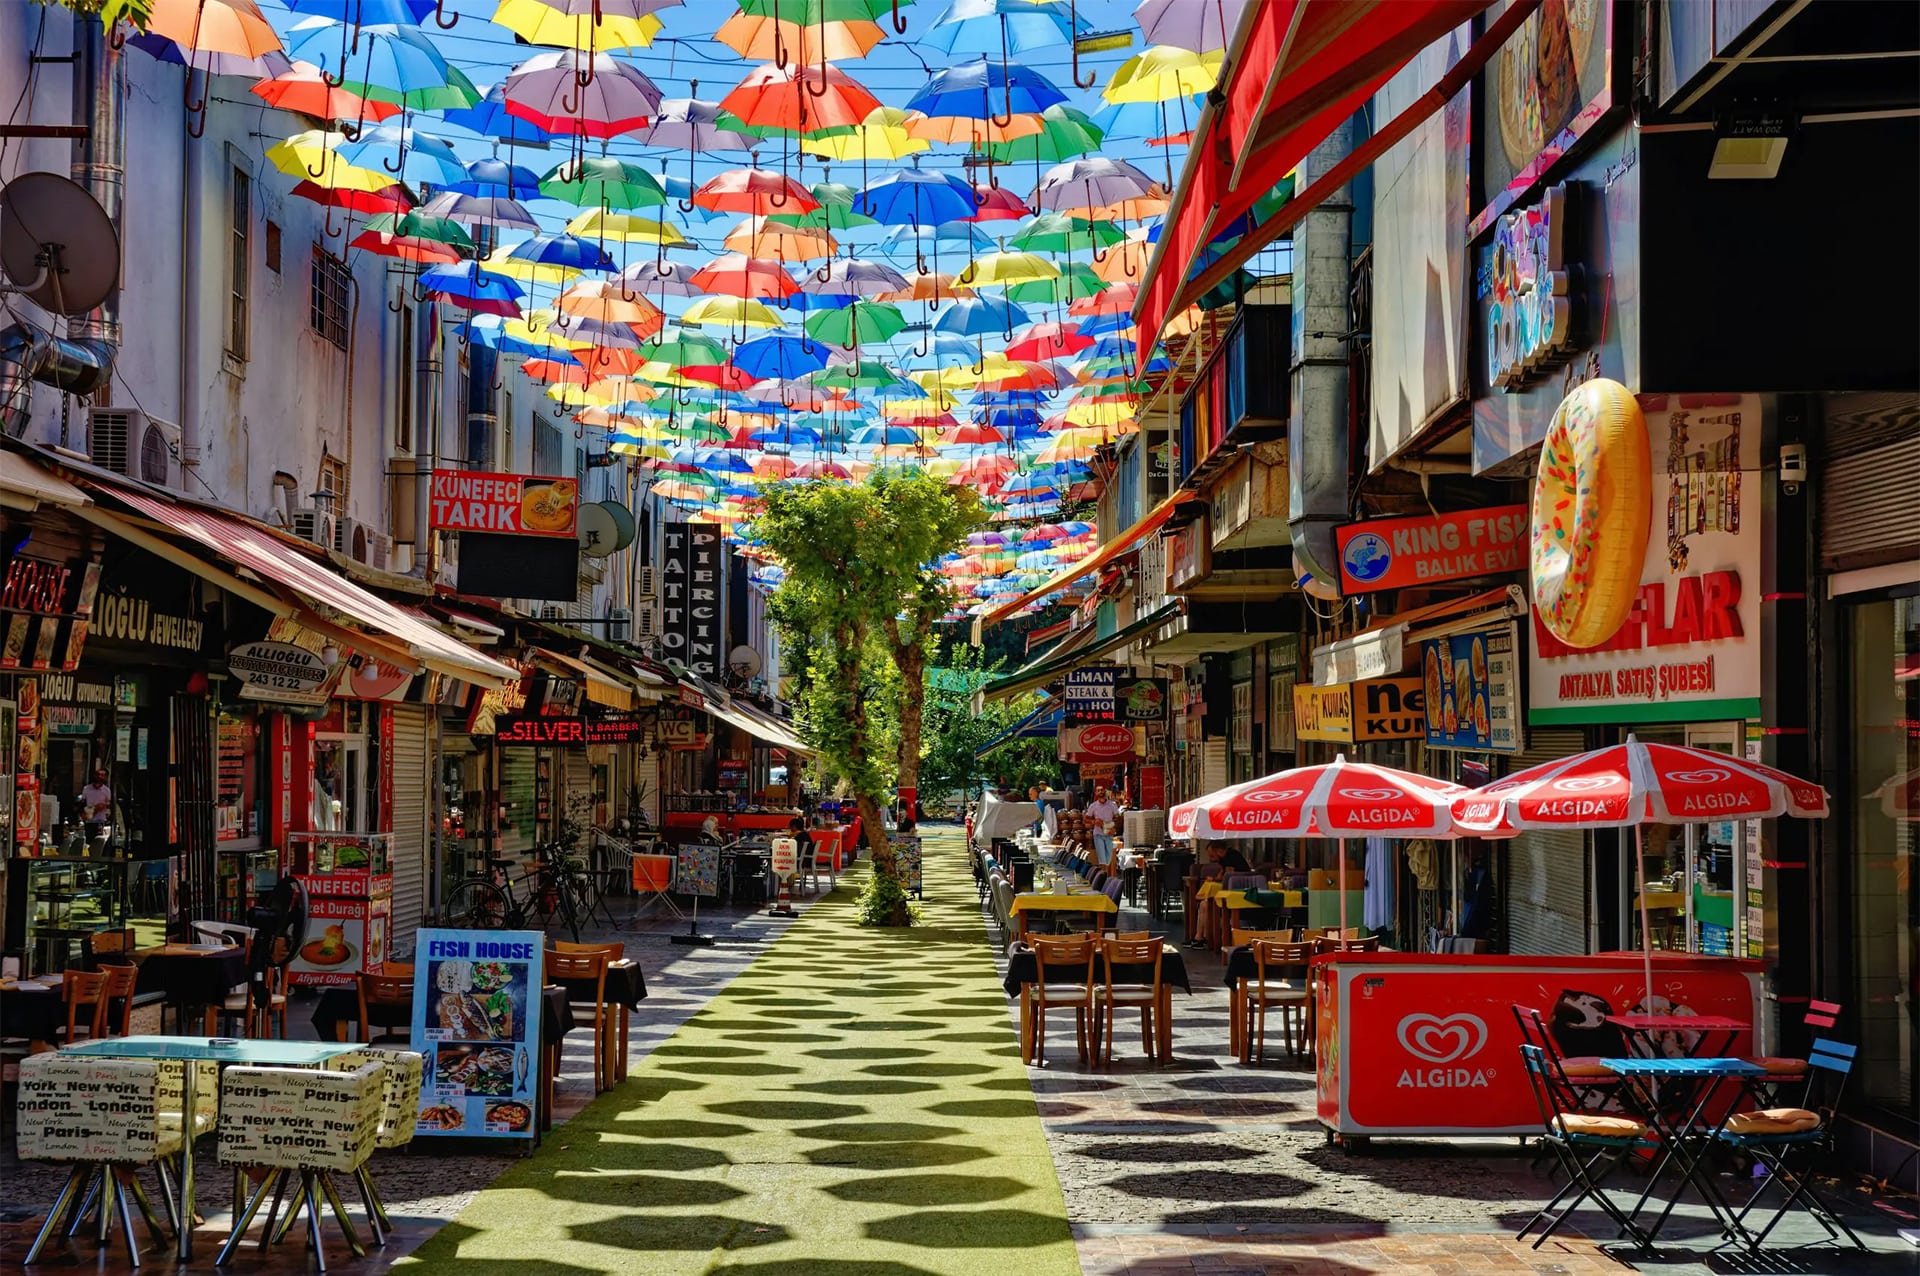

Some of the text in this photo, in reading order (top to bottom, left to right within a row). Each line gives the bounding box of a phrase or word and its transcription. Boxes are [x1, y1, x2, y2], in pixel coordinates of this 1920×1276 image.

[434, 472, 522, 503] KÜNEFECİ
[433, 500, 517, 531] TARIK
[1392, 523, 1460, 556] KING
[1416, 554, 1479, 578] BALIK
[691, 533, 715, 674] PIERCING
[151, 613, 204, 652] JEWELLERY
[246, 646, 313, 665] ALLIOĞLU
[249, 673, 300, 689] 243 12 22
[1559, 655, 1715, 701] ANTALYA SATIŞ ŞUBESİ
[1068, 687, 1109, 698] STEAK &
[1128, 709, 1161, 718] PIZZA
[1321, 690, 1350, 723] KUMAŞ
[512, 721, 584, 742] SILVER
[597, 722, 639, 732] BARBER
[661, 721, 689, 736] WC
[328, 902, 365, 917] Durağı
[429, 940, 534, 959] FISH HOUSE
[24, 1080, 139, 1095] York New York
[223, 1085, 268, 1097] Paris
[304, 1088, 349, 1103] Paris
[17, 1099, 155, 1114] ondon London
[43, 1126, 90, 1138] Paris
[242, 1115, 356, 1132] New York New
[263, 1134, 326, 1148] London
